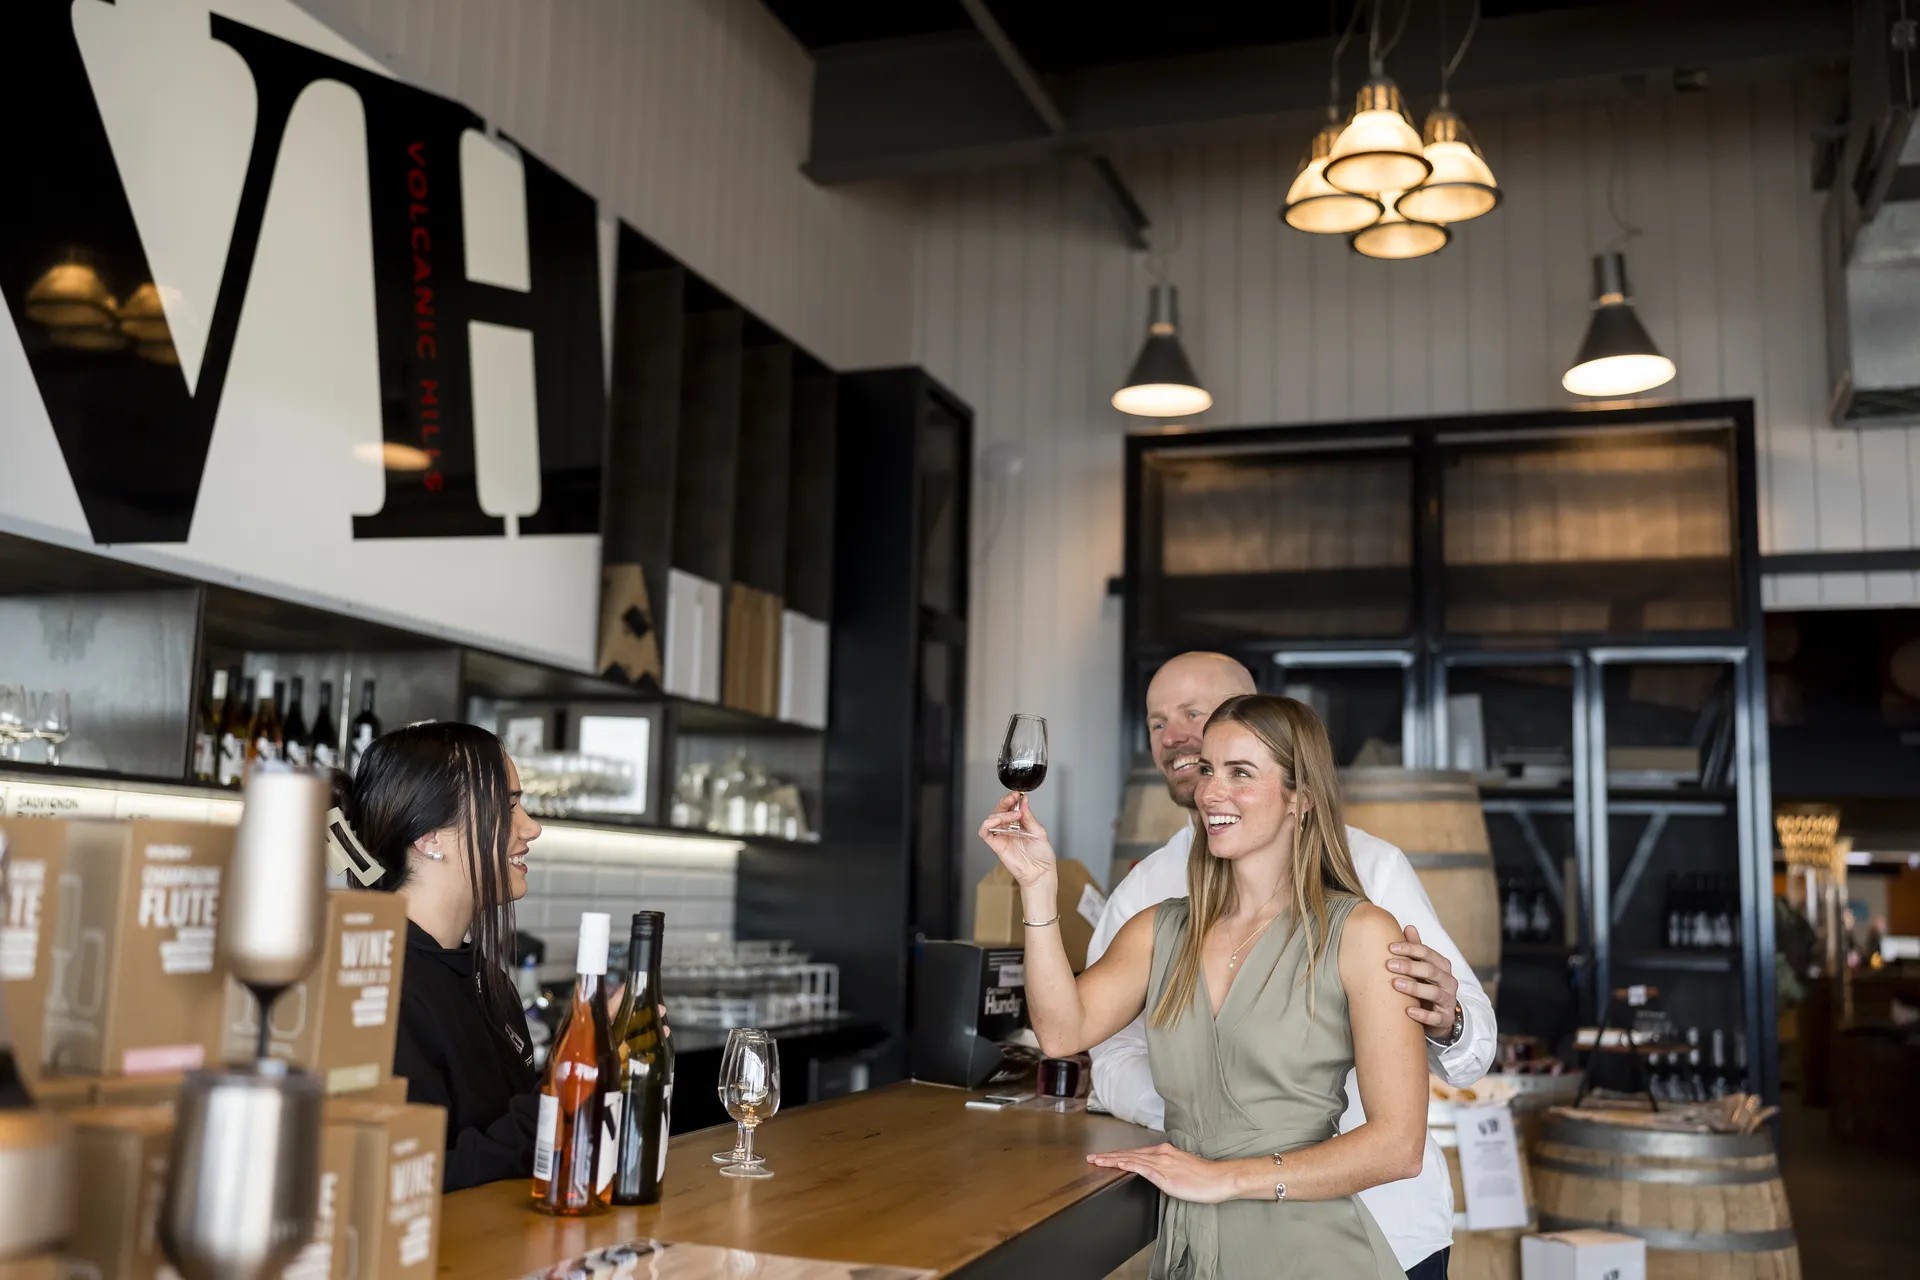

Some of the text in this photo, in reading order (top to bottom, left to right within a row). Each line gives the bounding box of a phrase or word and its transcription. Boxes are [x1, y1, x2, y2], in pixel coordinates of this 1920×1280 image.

[407, 142, 444, 491] VOLCANIC HILLS
[16, 796, 79, 810] SAUVIGNON
[138, 886, 220, 928] FLUTE
[341, 930, 395, 968] WINE
[391, 1152, 436, 1203] WINE
